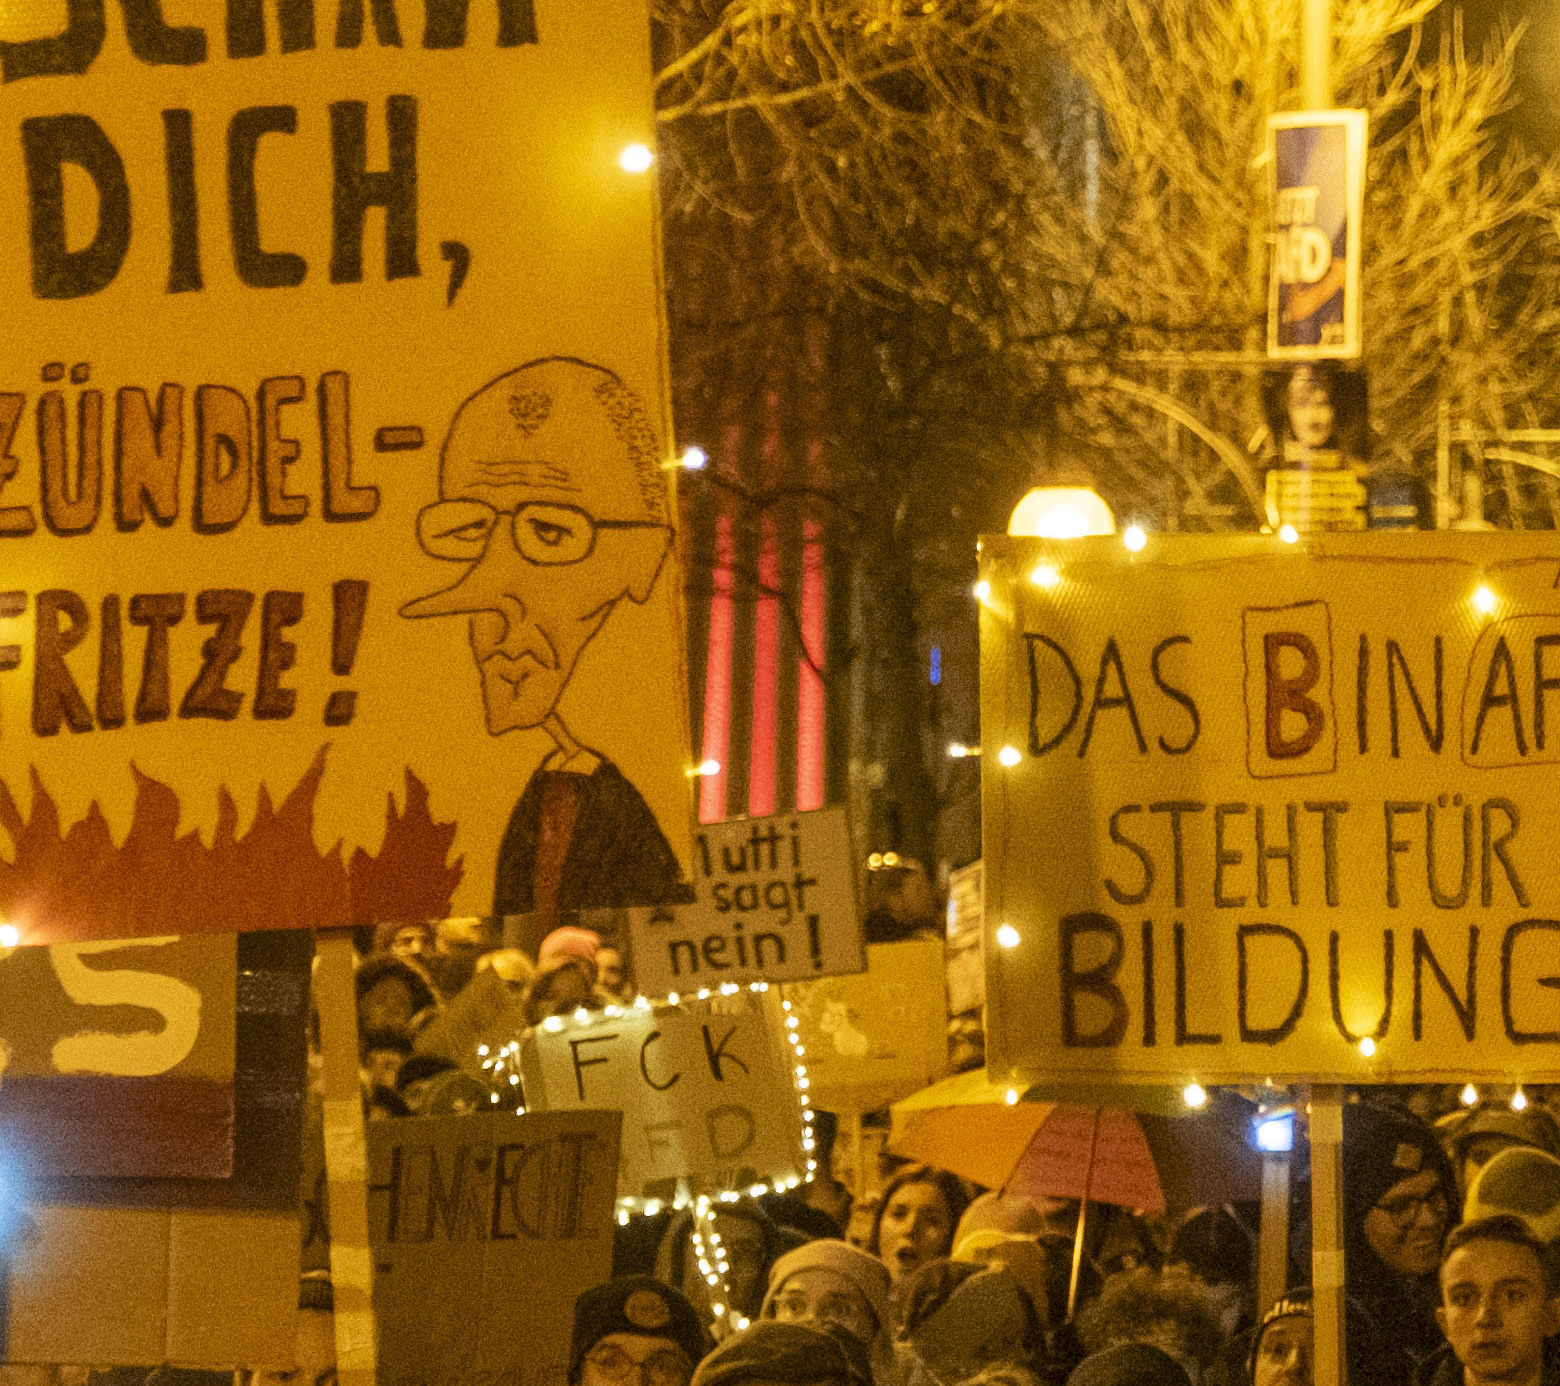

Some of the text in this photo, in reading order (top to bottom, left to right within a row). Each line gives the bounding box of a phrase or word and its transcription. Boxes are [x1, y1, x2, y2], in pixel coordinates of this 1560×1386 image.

[20, 93, 471, 308] DICH,
[1022, 632, 1202, 758] DAS
[713, 873, 817, 926] sagt
[1103, 791, 1532, 911] STEHT FÜR
[569, 1023, 750, 1103] FCK
